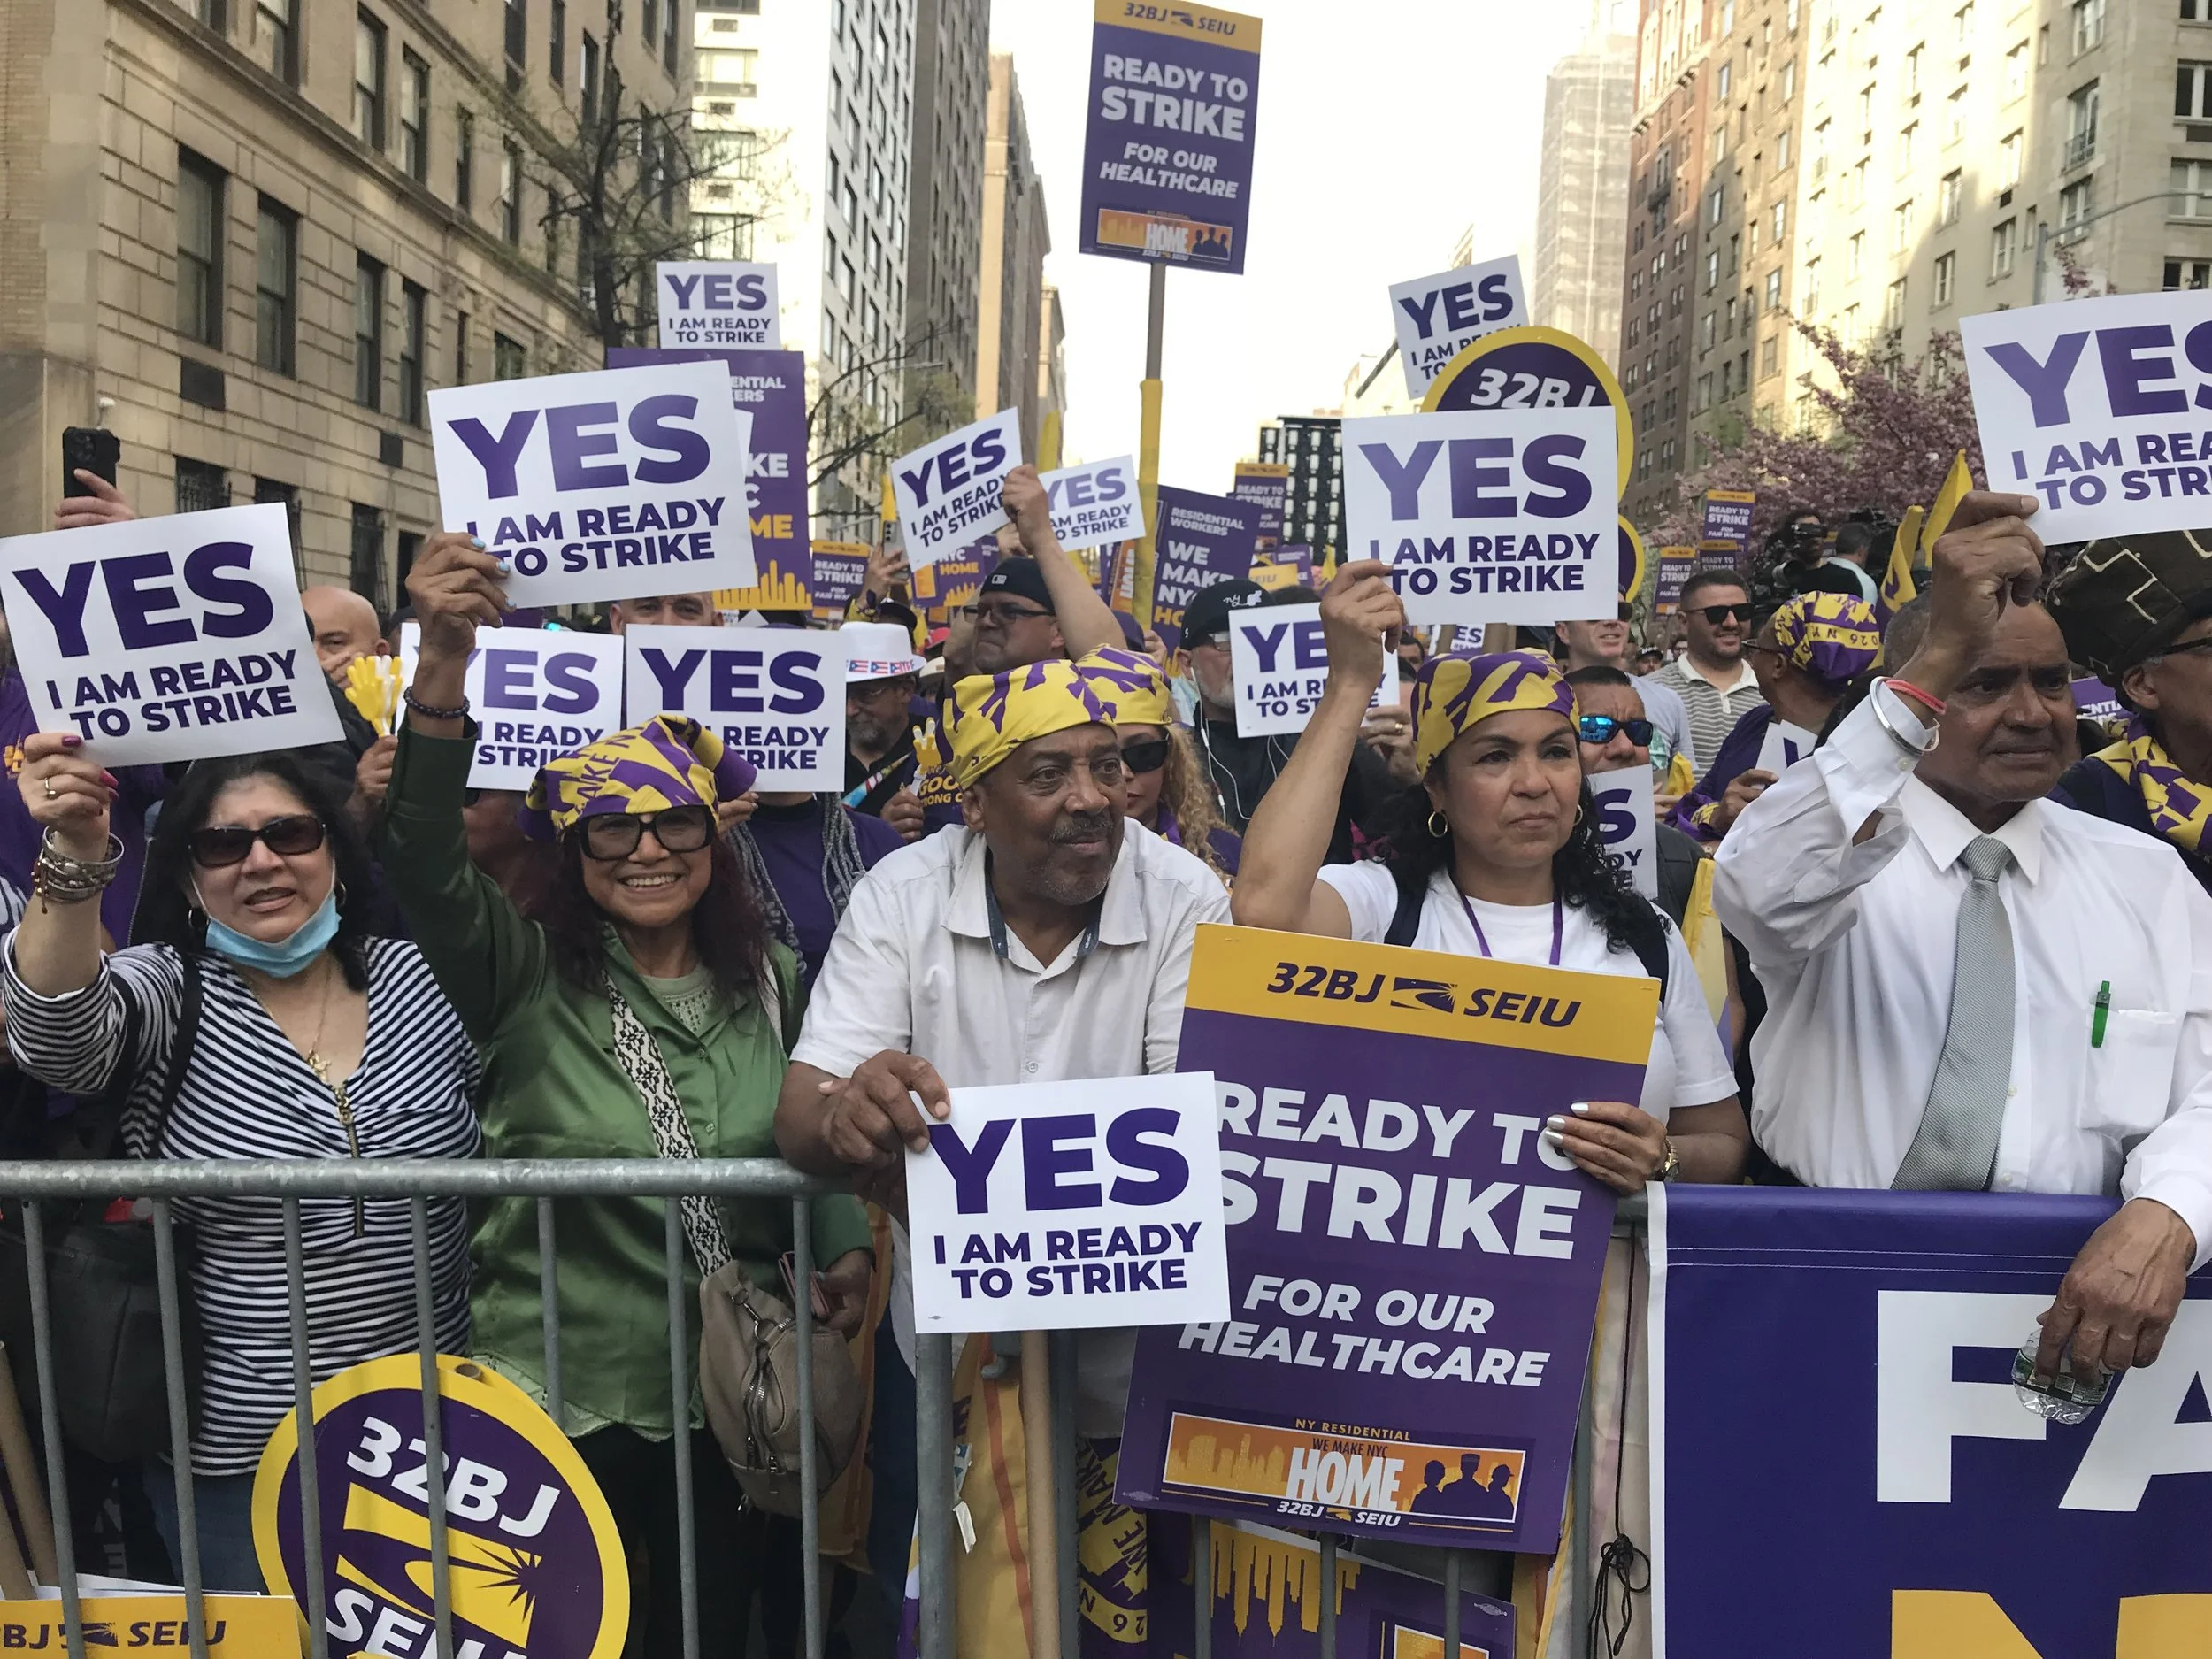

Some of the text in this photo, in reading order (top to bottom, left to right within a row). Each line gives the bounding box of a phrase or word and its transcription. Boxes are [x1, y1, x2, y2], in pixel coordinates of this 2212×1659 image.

[1124, 2, 1236, 35] 32BJ SEIU
[1103, 54, 1248, 102] READY TO
[1101, 86, 1246, 142] STRIKE
[1124, 142, 1217, 173] FOR OUR
[1099, 162, 1239, 199] HEALTHCARE
[1147, 223, 1189, 254] HOME
[664, 274, 767, 311] YES
[1398, 274, 1514, 340] YES
[669, 317, 771, 331] I AM READY
[675, 330, 765, 344] TO STRIKE
[1411, 342, 1454, 366] I AM
[447, 395, 710, 499] YES
[2012, 450, 2028, 480] I
[2044, 437, 2124, 475] AM
[745, 453, 789, 477] KE
[900, 428, 1006, 508] YES
[1358, 434, 1592, 521] YES
[2035, 465, 2212, 510] TO STR
[493, 511, 564, 547] AM
[577, 497, 726, 538] READY
[749, 514, 793, 539] ME
[910, 522, 917, 536] I
[921, 507, 947, 531] AM
[1071, 517, 1129, 538] STRIKE
[1077, 503, 1132, 524] READY
[1171, 507, 1244, 530] RESIDENTIAL
[1171, 517, 1228, 536] WORKERS
[1708, 514, 1749, 526] STRIKE
[563, 532, 715, 572] STRIKE
[920, 526, 944, 548] TO
[1370, 533, 1601, 565] I AM READY
[814, 560, 864, 573] READY TO
[940, 562, 979, 575] HOME
[1168, 541, 1210, 565] WE
[814, 572, 864, 585] STRIKE
[1390, 564, 1585, 595] TO STRIKE
[12, 541, 273, 658] YES
[1157, 583, 1197, 607] NY
[1154, 606, 1185, 628] HO
[1240, 620, 1329, 673] YE
[1455, 625, 1482, 643] ES
[46, 649, 296, 709] I AM READY
[639, 648, 825, 715] YES
[1248, 685, 1253, 700] I
[1261, 680, 1299, 699] AM
[70, 686, 296, 741] TO STRIKE
[1256, 701, 1288, 718] TO
[495, 722, 603, 746] READY
[723, 726, 830, 748] READY
[1266, 962, 1581, 1028] 32BJ SEIU
[1217, 1079, 1476, 1159] READY
[927, 1107, 1189, 1215] YES
[1221, 1150, 1583, 1262] STRIKE
[933, 1221, 1202, 1265] I AM READY
[951, 1258, 1187, 1299] TO STRIKE
[1242, 1274, 1495, 1335] FOR OUR
[1177, 1321, 1551, 1387] HEALTHCARE
[1294, 1418, 1411, 1441] NY RESIDENTIAL
[1312, 1437, 1389, 1458] WE MAKE NYC
[346, 1417, 562, 1539] 32BJ
[1286, 1447, 1405, 1512] HOME
[1276, 1501, 1402, 1528] 32BJ SEIU
[1, 1624, 50, 1650] BJ
